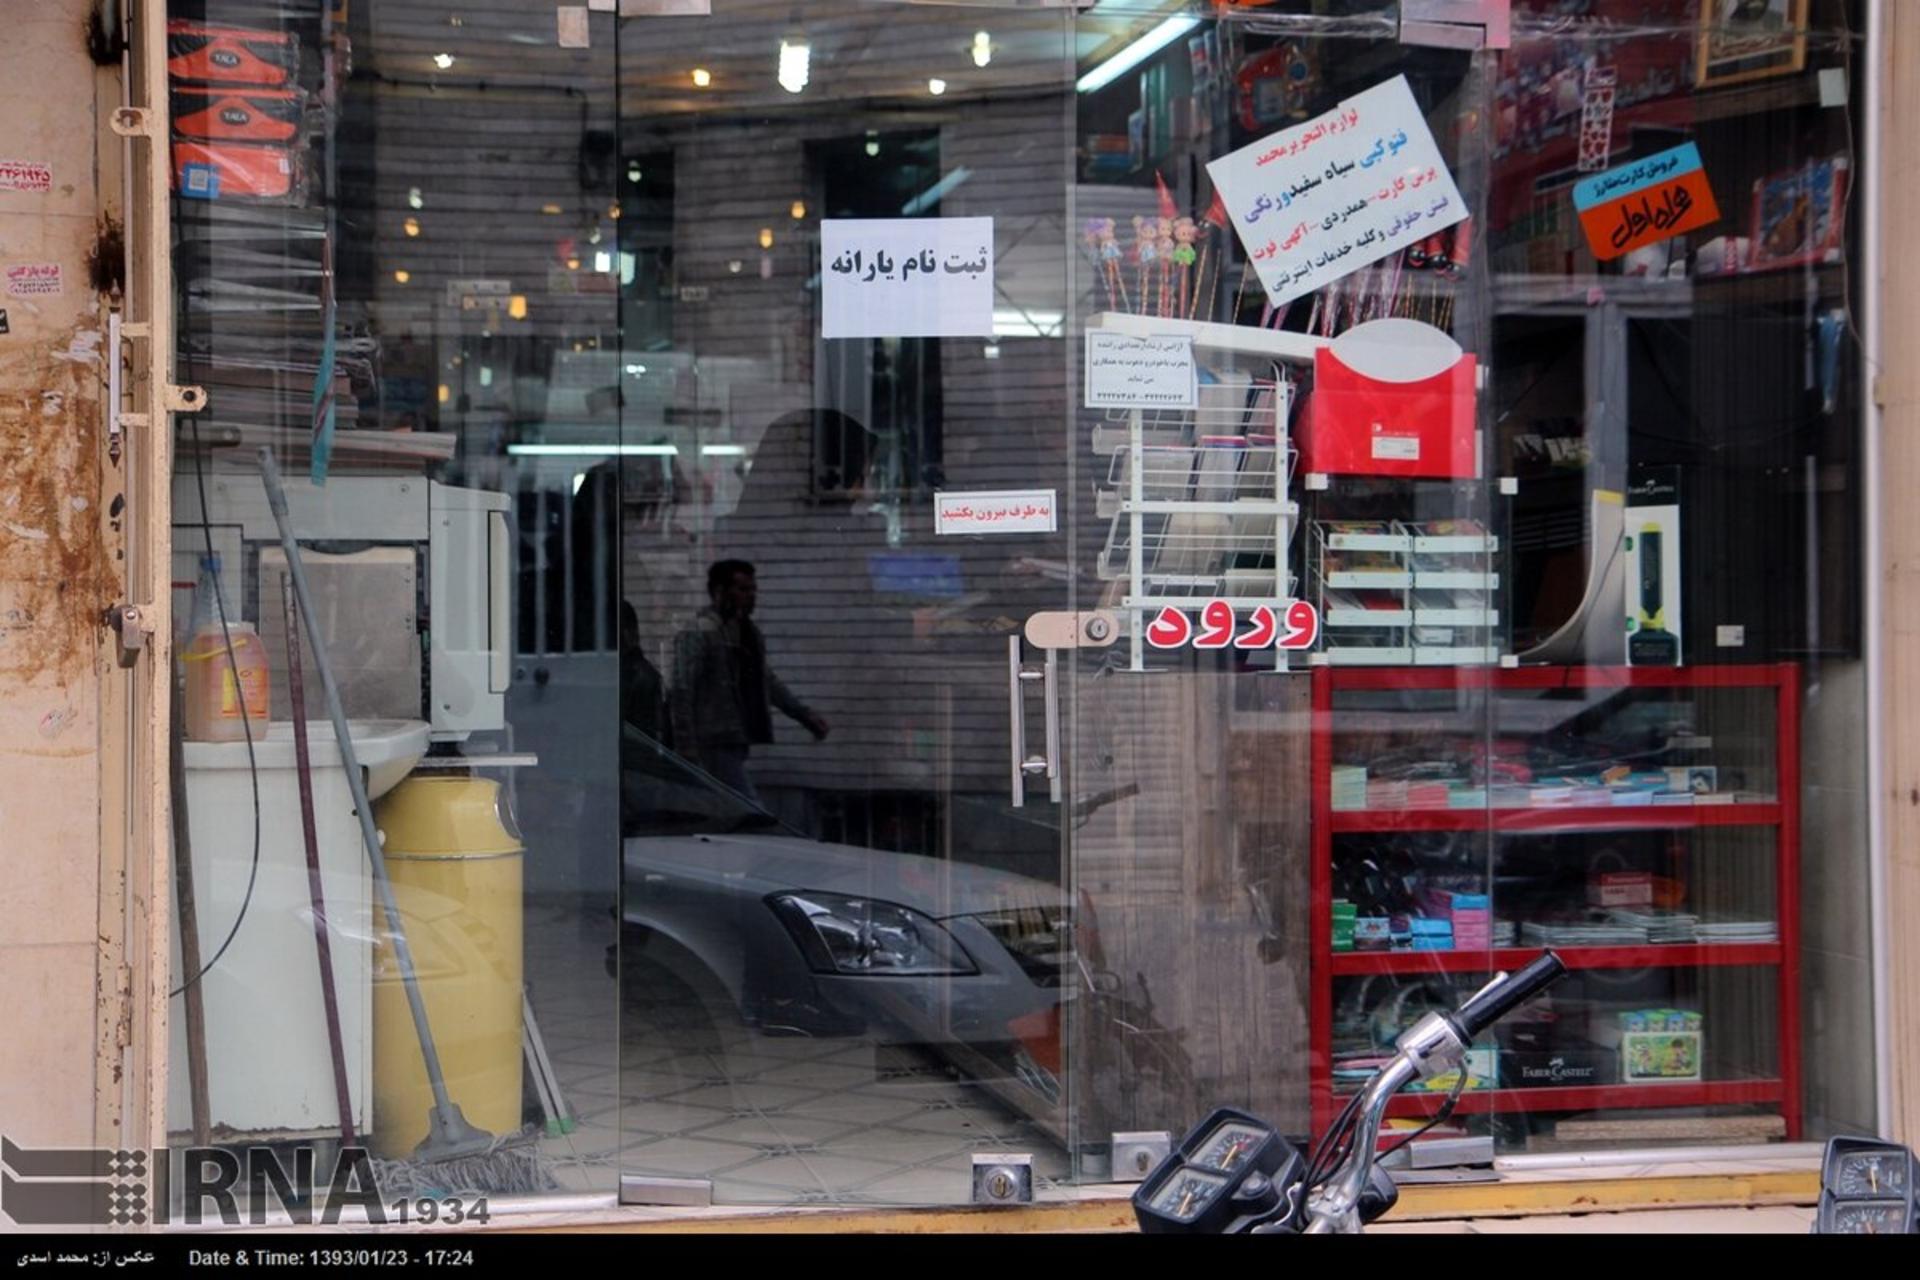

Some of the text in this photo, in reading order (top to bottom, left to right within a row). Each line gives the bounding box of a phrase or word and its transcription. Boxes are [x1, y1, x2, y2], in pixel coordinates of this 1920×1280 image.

[1330, 108, 1358, 134] لوازم
[1256, 147, 1287, 166] محمد
[1647, 155, 1679, 179] فروش
[1325, 160, 1355, 180] سیاه
[831, 246, 988, 283] ثبت نام یارانه
[1315, 241, 1352, 267] خدمات
[942, 504, 1050, 521] به طرف بیرون بکشید
[1147, 600, 1317, 649] ورود
